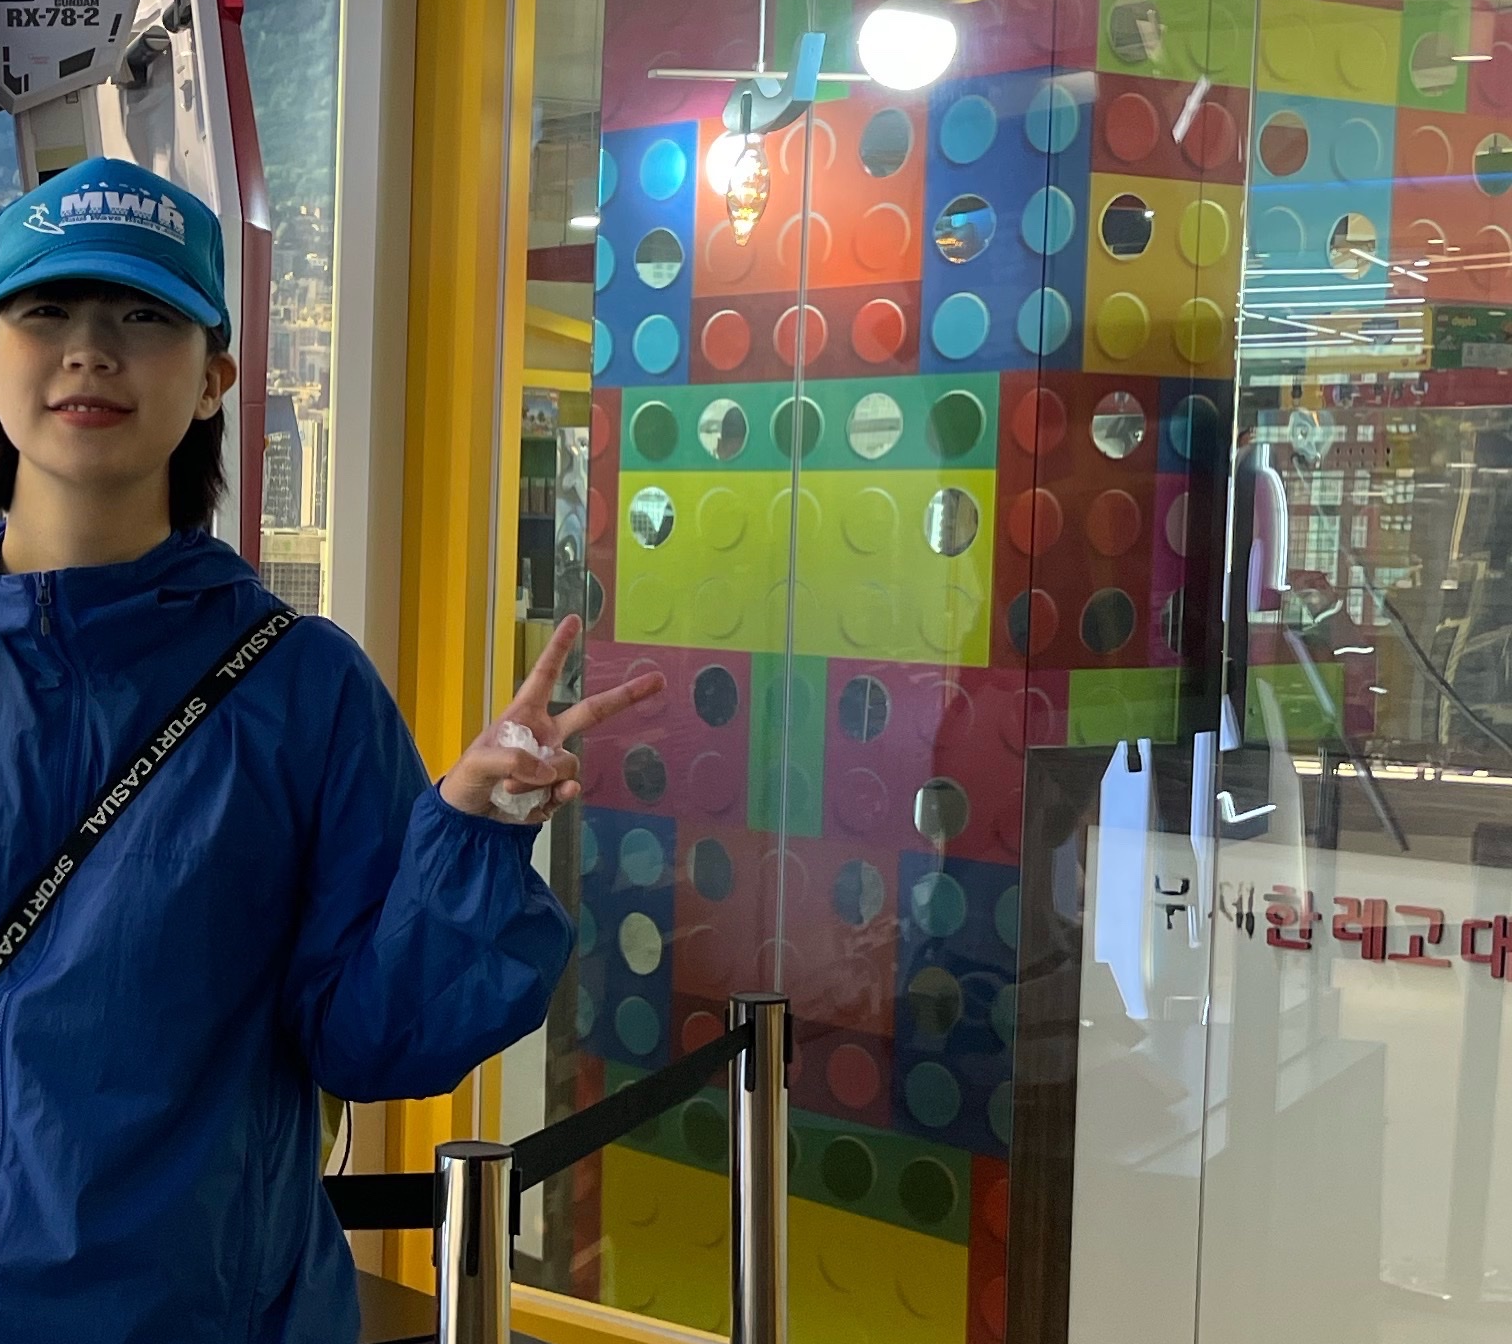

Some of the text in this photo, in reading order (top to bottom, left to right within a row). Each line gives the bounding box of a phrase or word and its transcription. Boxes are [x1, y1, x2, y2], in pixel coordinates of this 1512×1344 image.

[6, 7, 100, 28] RX-78-2
[60, 191, 185, 235] MWR
[216, 613, 291, 679] CASUAL
[79, 696, 208, 835] SPORT CASUAL
[28, 854, 74, 926] SPORT
